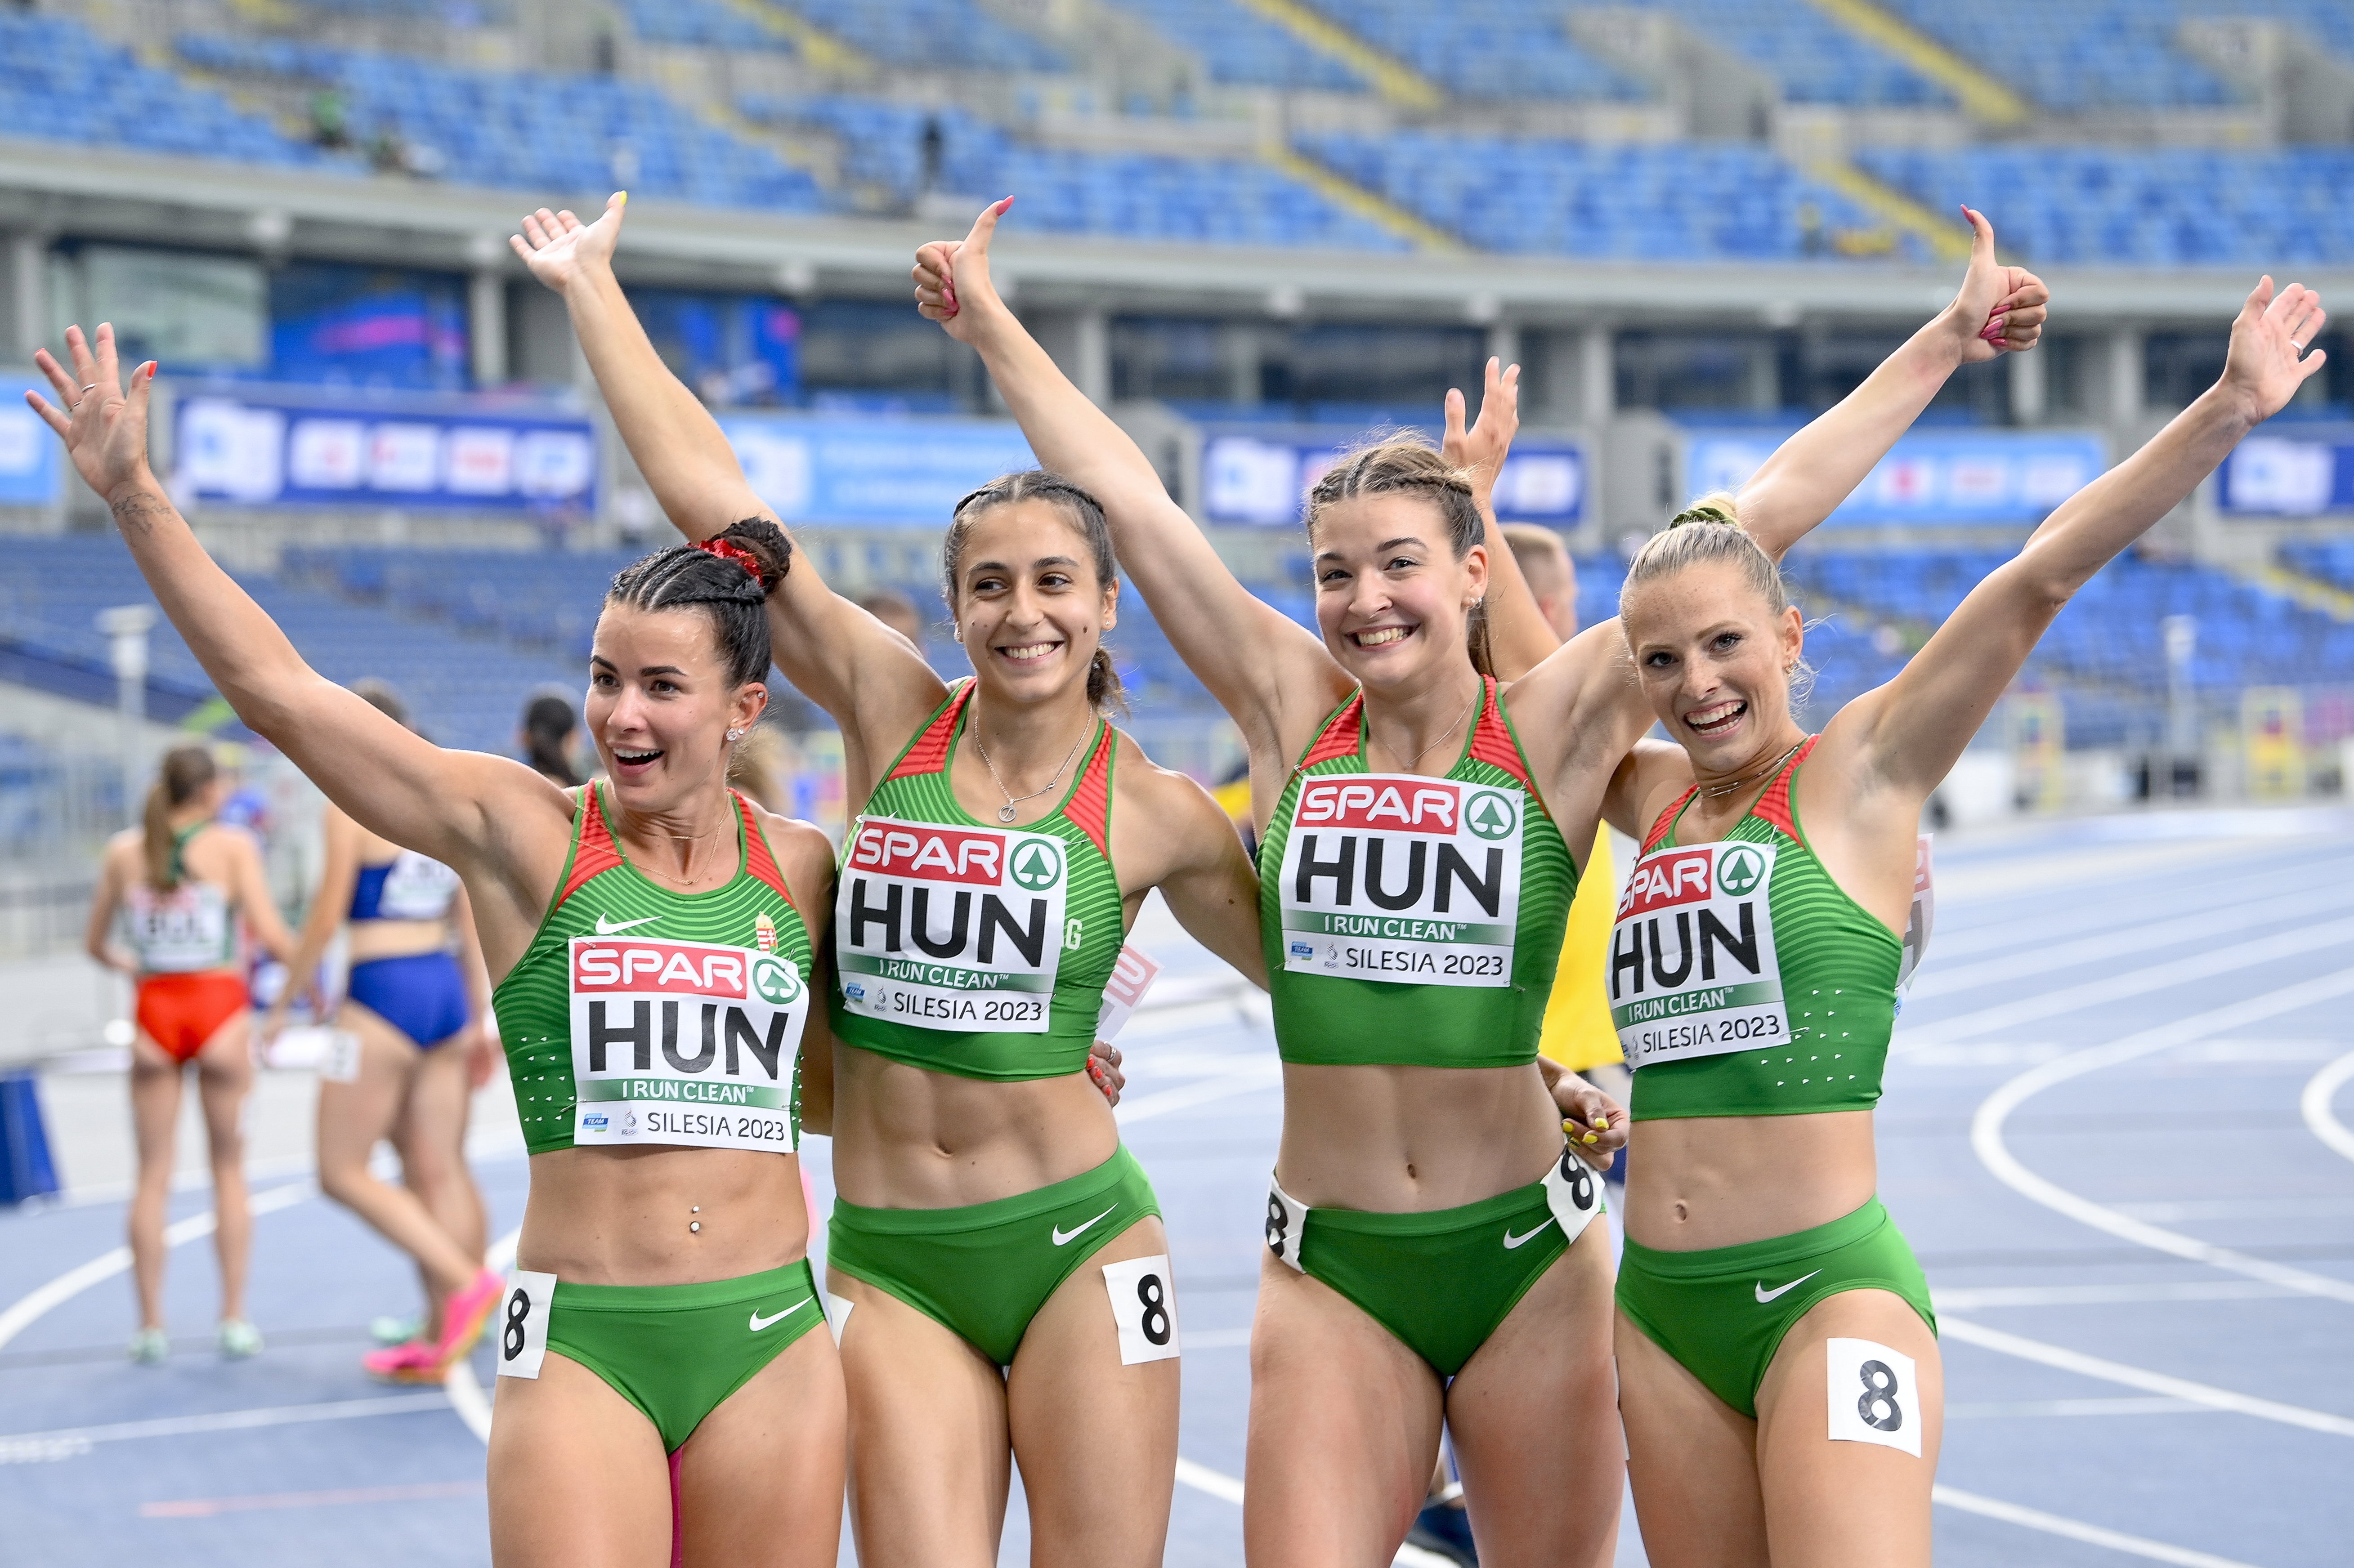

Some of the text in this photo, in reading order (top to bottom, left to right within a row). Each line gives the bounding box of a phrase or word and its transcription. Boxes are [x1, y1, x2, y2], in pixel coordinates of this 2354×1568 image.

[1302, 786, 1455, 827] SPAR
[855, 829, 999, 879] SPAR
[1295, 835, 1504, 918] HUN
[1619, 857, 1708, 916] SPAR
[850, 878, 1047, 968] HUN
[1325, 915, 1329, 931] I
[1334, 916, 1379, 935] RUN
[578, 948, 743, 992] SPAR
[879, 959, 884, 974] I
[887, 960, 925, 982] RUN
[1345, 947, 1503, 976] SILESIA 2023
[1613, 902, 1760, 1000] HUN
[893, 992, 1042, 1021] SILESIA 2023
[1634, 998, 1665, 1021] RUN
[589, 1001, 789, 1080] HUN
[1643, 1015, 1779, 1053] SILESIA 2023
[622, 1081, 627, 1098] I
[633, 1081, 679, 1099] RUN
[647, 1112, 784, 1141] SILESIA 2023
[1561, 1147, 1593, 1211] 8
[1266, 1192, 1288, 1258] 8
[504, 1288, 531, 1361] 8
[1137, 1274, 1170, 1345] 8
[1858, 1360, 1902, 1431] 8
